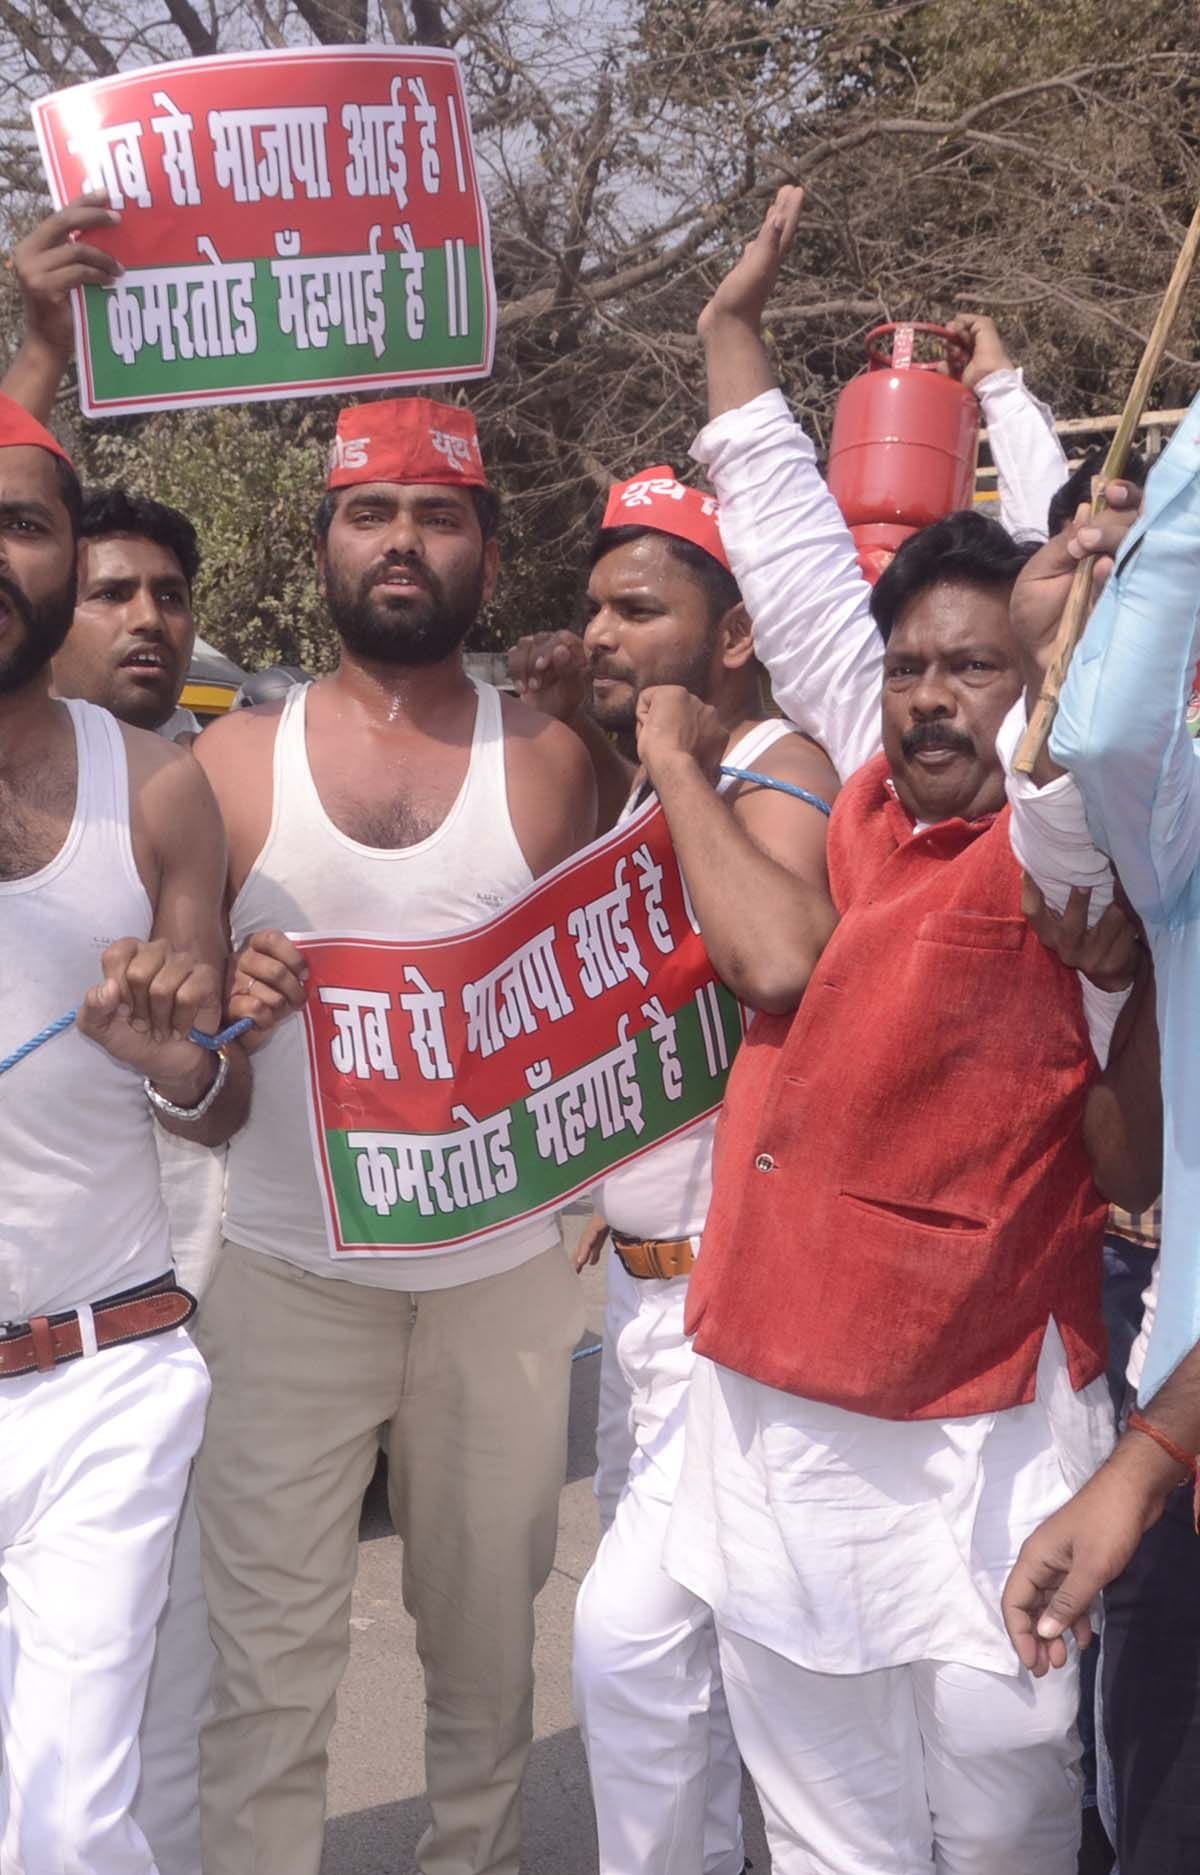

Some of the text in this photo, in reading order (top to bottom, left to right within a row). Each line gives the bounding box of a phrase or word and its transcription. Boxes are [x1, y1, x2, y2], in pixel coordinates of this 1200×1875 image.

[152, 92, 200, 206] से
[208, 105, 332, 202] भाजपा
[341, 76, 409, 210] आई
[408, 76, 440, 194] है
[102, 236, 257, 365] कमरतोड
[270, 225, 387, 360] मँहगाई
[393, 224, 425, 341] है
[318, 986, 400, 1081] जब
[400, 964, 455, 1081] से
[461, 924, 574, 1058] भाजपा
[567, 856, 650, 999] आई
[633, 843, 675, 955] है
[346, 1103, 518, 1216] कमरतोड
[524, 1013, 646, 1166] मँहगाई
[642, 995, 684, 1102] है
